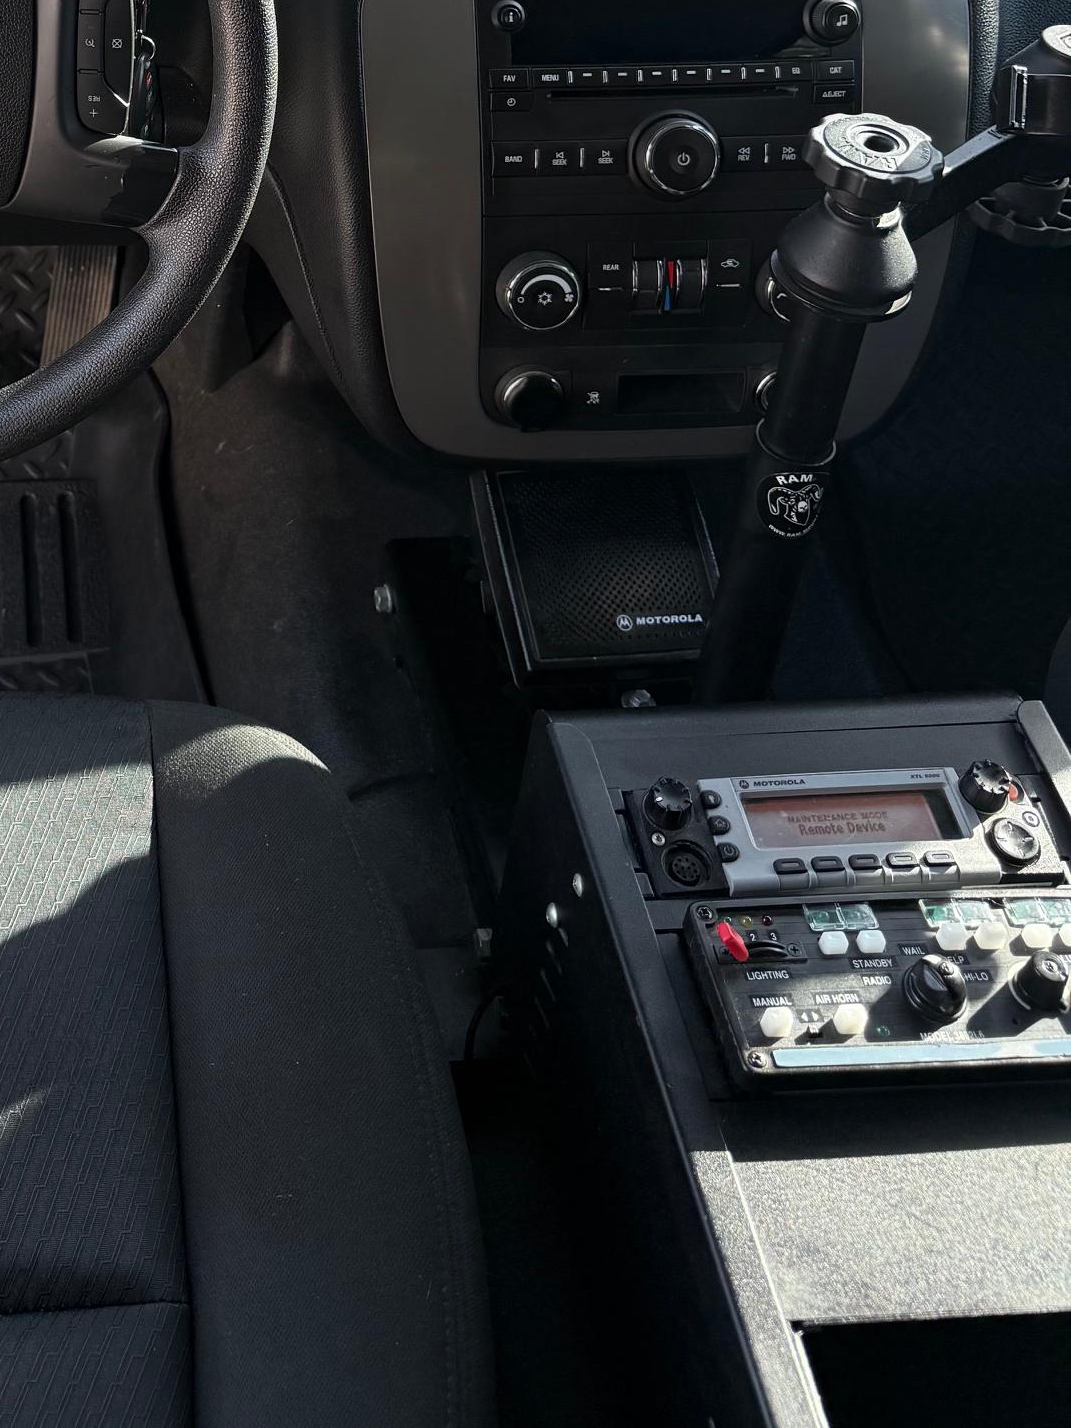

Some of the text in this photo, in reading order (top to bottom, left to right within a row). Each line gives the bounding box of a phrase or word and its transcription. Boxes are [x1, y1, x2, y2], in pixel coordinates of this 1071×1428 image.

[829, 66, 842, 74] CAT
[503, 74, 516, 83] FAV
[541, 74, 560, 82] MENU
[827, 90, 847, 98] EJECT
[504, 155, 523, 163] BAND
[781, 153, 796, 161] FWD
[552, 158, 568, 166] SEEK
[775, 473, 814, 486] RAM
[635, 613, 703, 626] MOTOROLA
[753, 778, 806, 787] MOTOROLA
[799, 820, 886, 836] Remote Device
[749, 933, 757, 942] 2
[770, 932, 778, 941] 3
[902, 946, 926, 956] WAIL
[852, 958, 893, 969] STANDBY
[947, 955, 965, 965] ELP
[746, 969, 790, 981] LIGHTING
[862, 975, 892, 987] RADIO
[752, 995, 793, 1007] MANUAL
[815, 992, 860, 1005] AIR HORN
